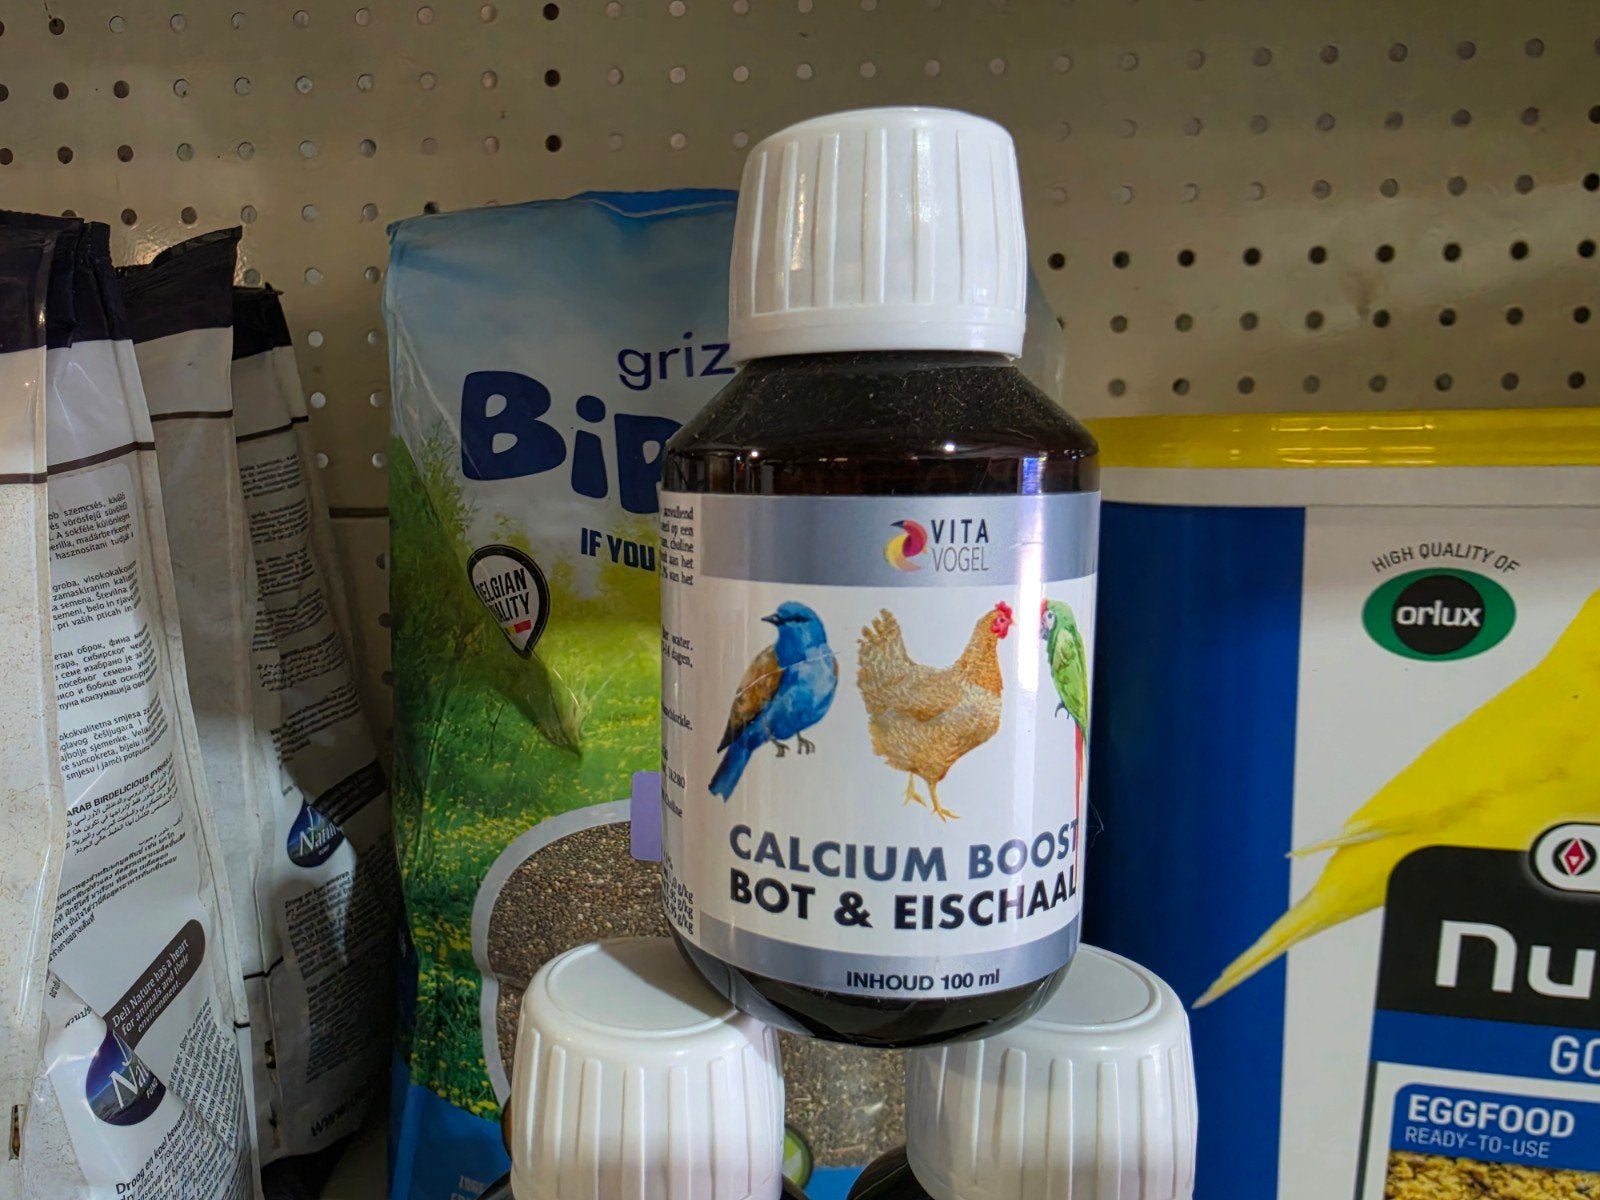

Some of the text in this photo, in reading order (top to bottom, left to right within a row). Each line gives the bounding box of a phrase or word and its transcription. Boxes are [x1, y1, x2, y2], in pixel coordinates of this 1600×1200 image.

[617, 331, 735, 391] griz
[581, 528, 602, 555] IF
[606, 535, 656, 571] YOU
[931, 519, 989, 544] VITA
[932, 547, 989, 572] VOGEL
[1371, 542, 1521, 574] HIGH QUALITY OF
[1396, 600, 1482, 627] orlux
[66, 802, 92, 817] ARAB
[93, 773, 150, 809] BIRDELICIOUS
[729, 817, 1080, 881] CALCIUM BOOST
[730, 867, 816, 920] BOT
[833, 890, 874, 929] &
[893, 863, 1077, 930] EISCHAAL
[846, 968, 1000, 991] INHOUD 100 ml
[1435, 919, 1596, 1000] nu
[111, 938, 189, 1028] Deli Nature has a heart
[121, 1018, 135, 1036] for
[135, 987, 163, 1021] animals
[161, 970, 175, 990] and
[138, 980, 182, 1033] environment.
[1408, 1093, 1576, 1139] EGGFOOD
[115, 1168, 145, 1195] Droog
[145, 1156, 154, 1171] en
[153, 1136, 168, 1160] koel
[1404, 1126, 1550, 1159] READY-TO-USE
